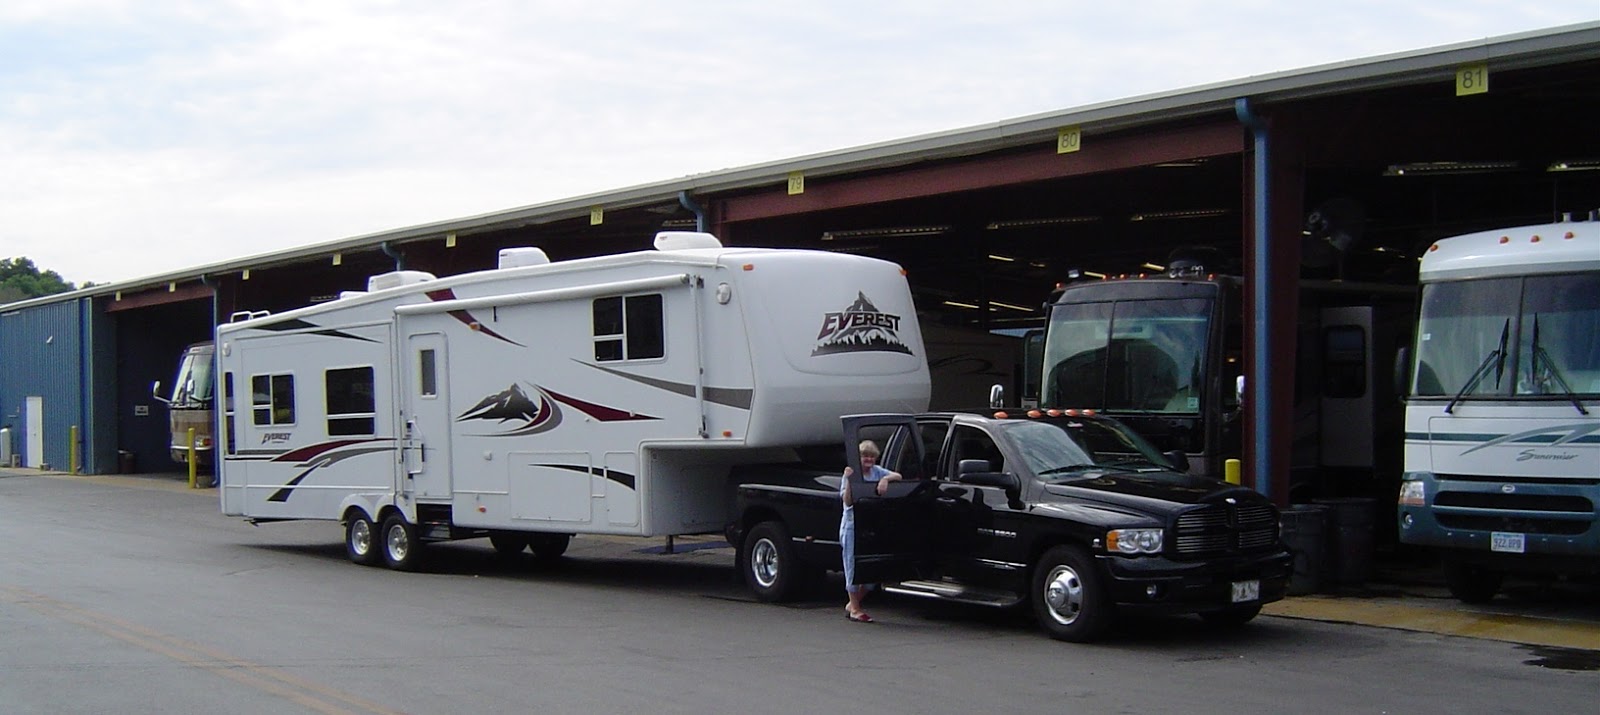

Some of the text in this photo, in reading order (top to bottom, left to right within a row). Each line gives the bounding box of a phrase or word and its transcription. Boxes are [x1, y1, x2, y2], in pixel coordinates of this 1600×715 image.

[1463, 70, 1482, 89] 81
[1062, 132, 1077, 148] 80
[790, 177, 802, 190] 79
[817, 312, 901, 341] EVEREST
[261, 433, 291, 445] EVEREST
